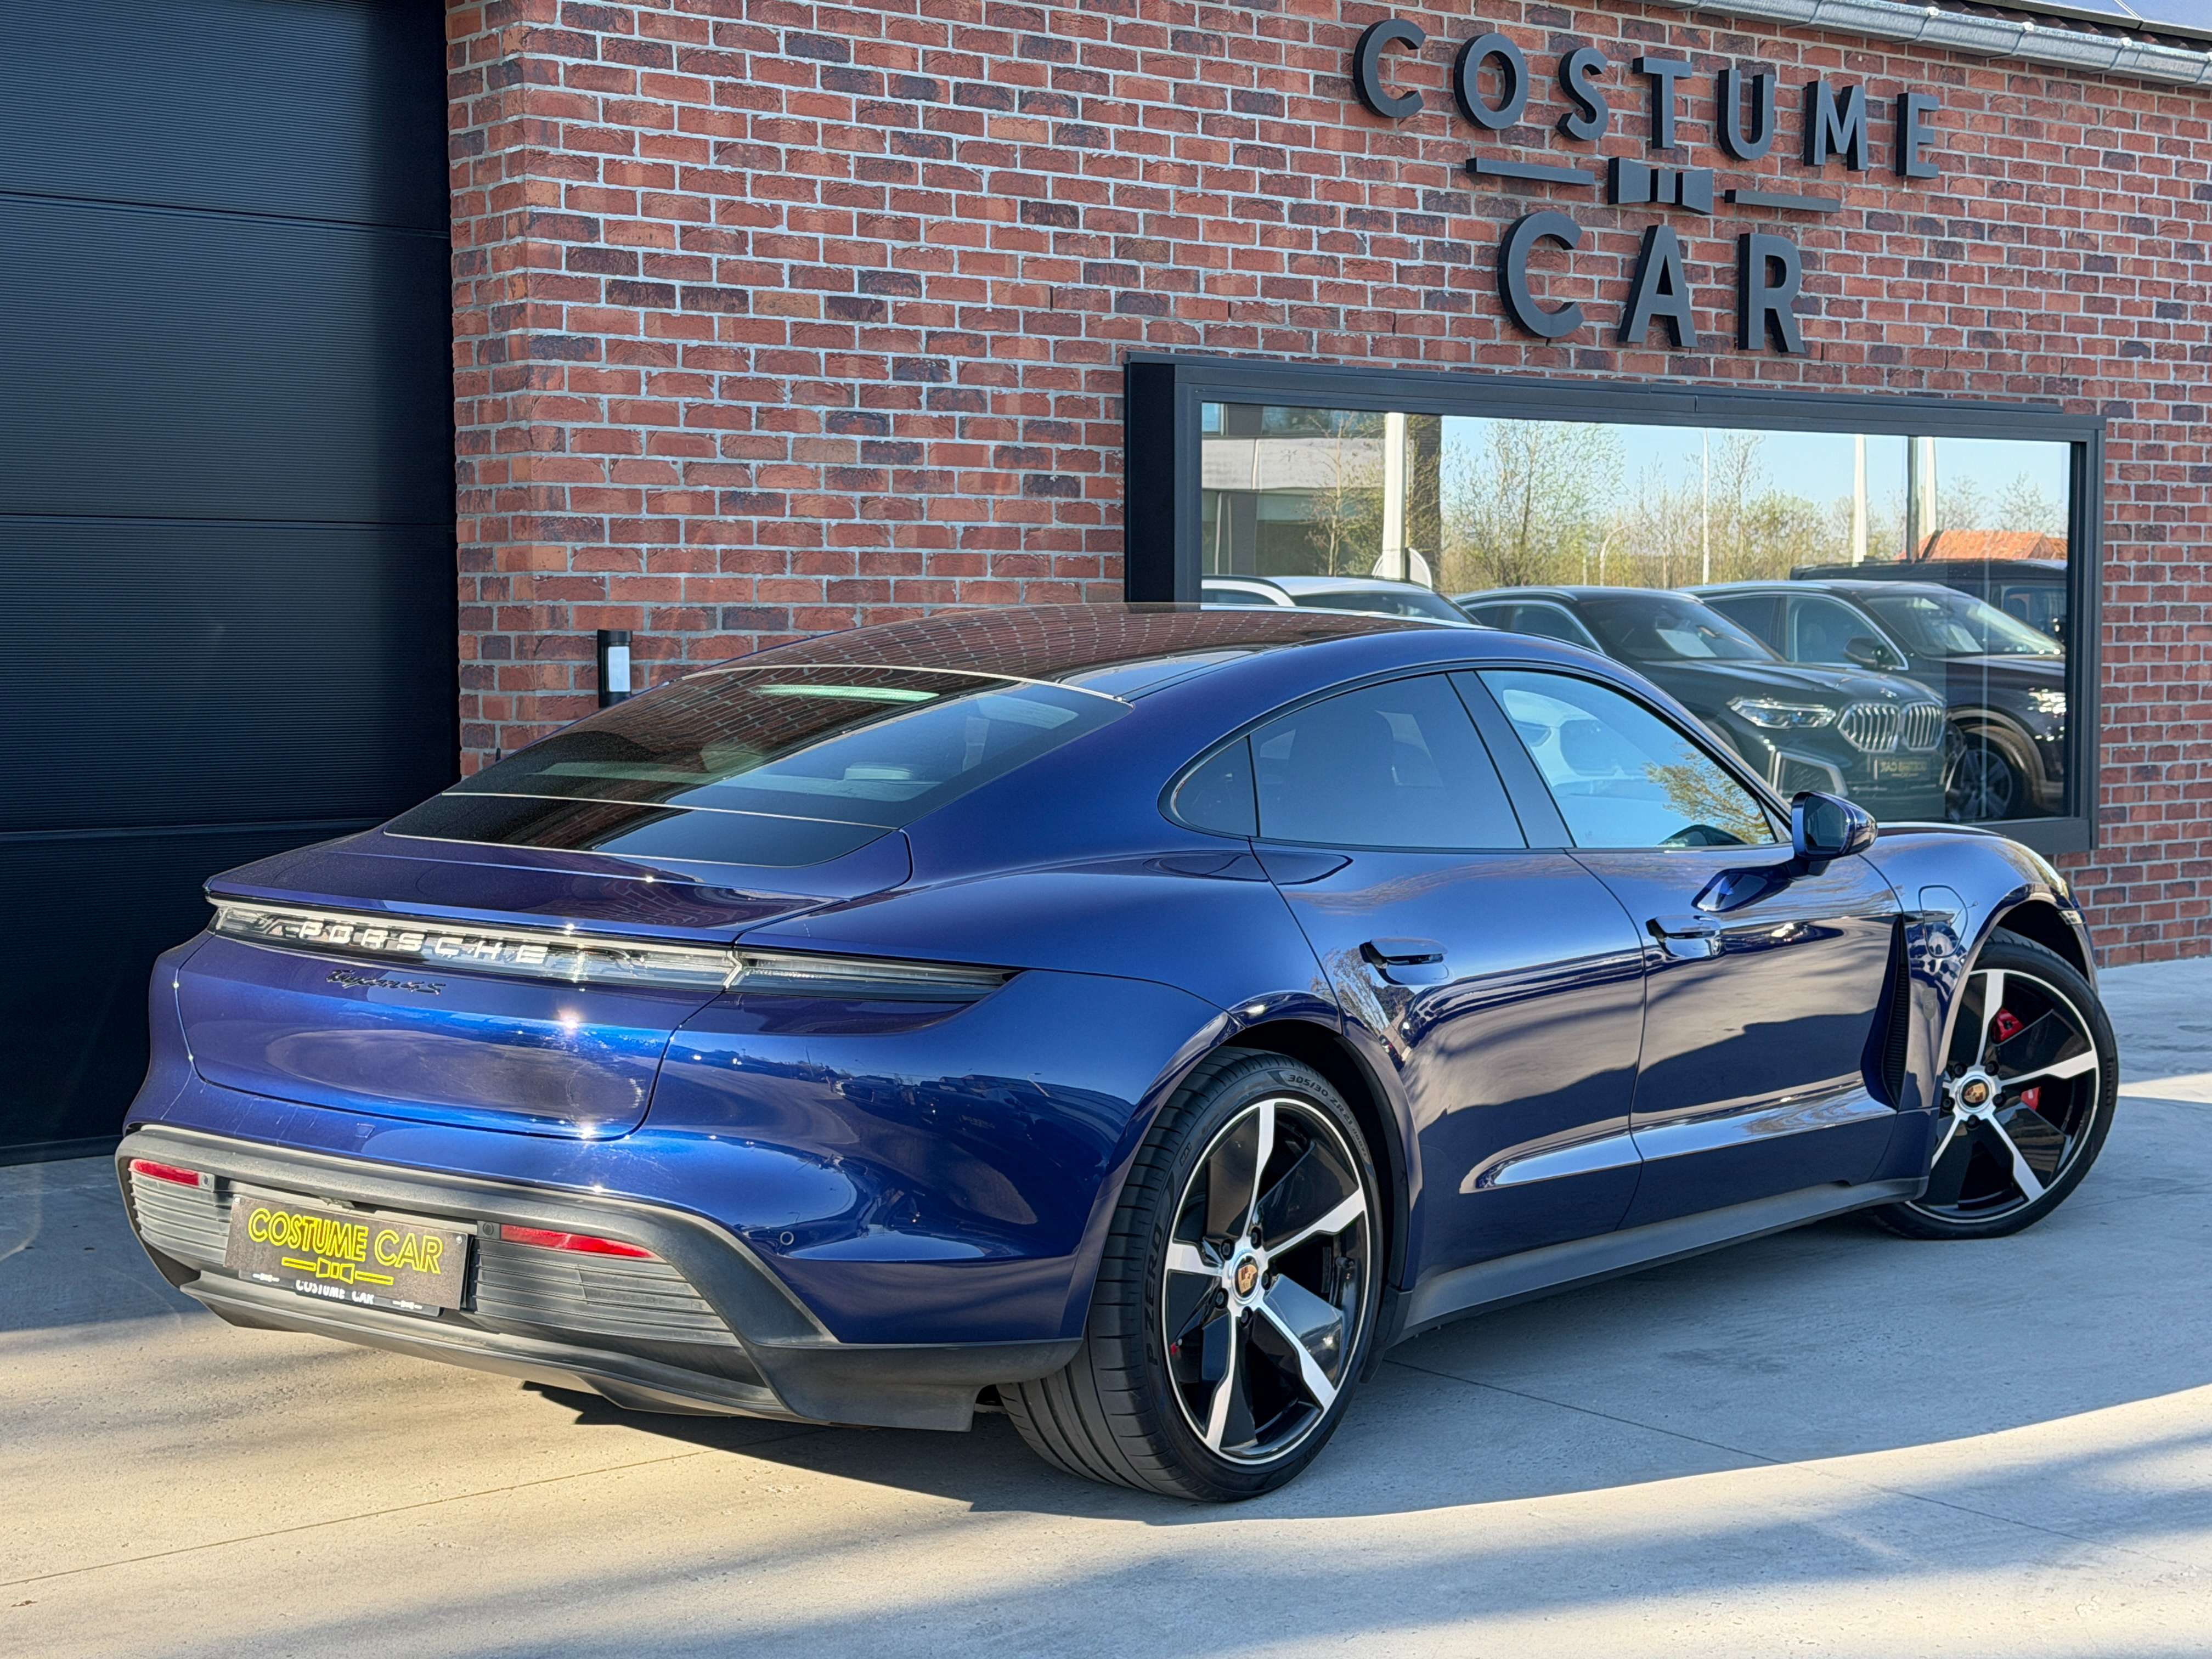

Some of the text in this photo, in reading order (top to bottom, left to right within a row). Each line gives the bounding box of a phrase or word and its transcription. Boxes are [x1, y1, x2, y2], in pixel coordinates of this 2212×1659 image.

[1353, 18, 1939, 180] COSTUME
[1498, 210, 1806, 354] CAR
[298, 921, 550, 964] PORSCHE
[1288, 1074, 1329, 1097] 305/30
[249, 1207, 443, 1274] COSTUME CAR
[1144, 1222, 1163, 1365] P ZERO
